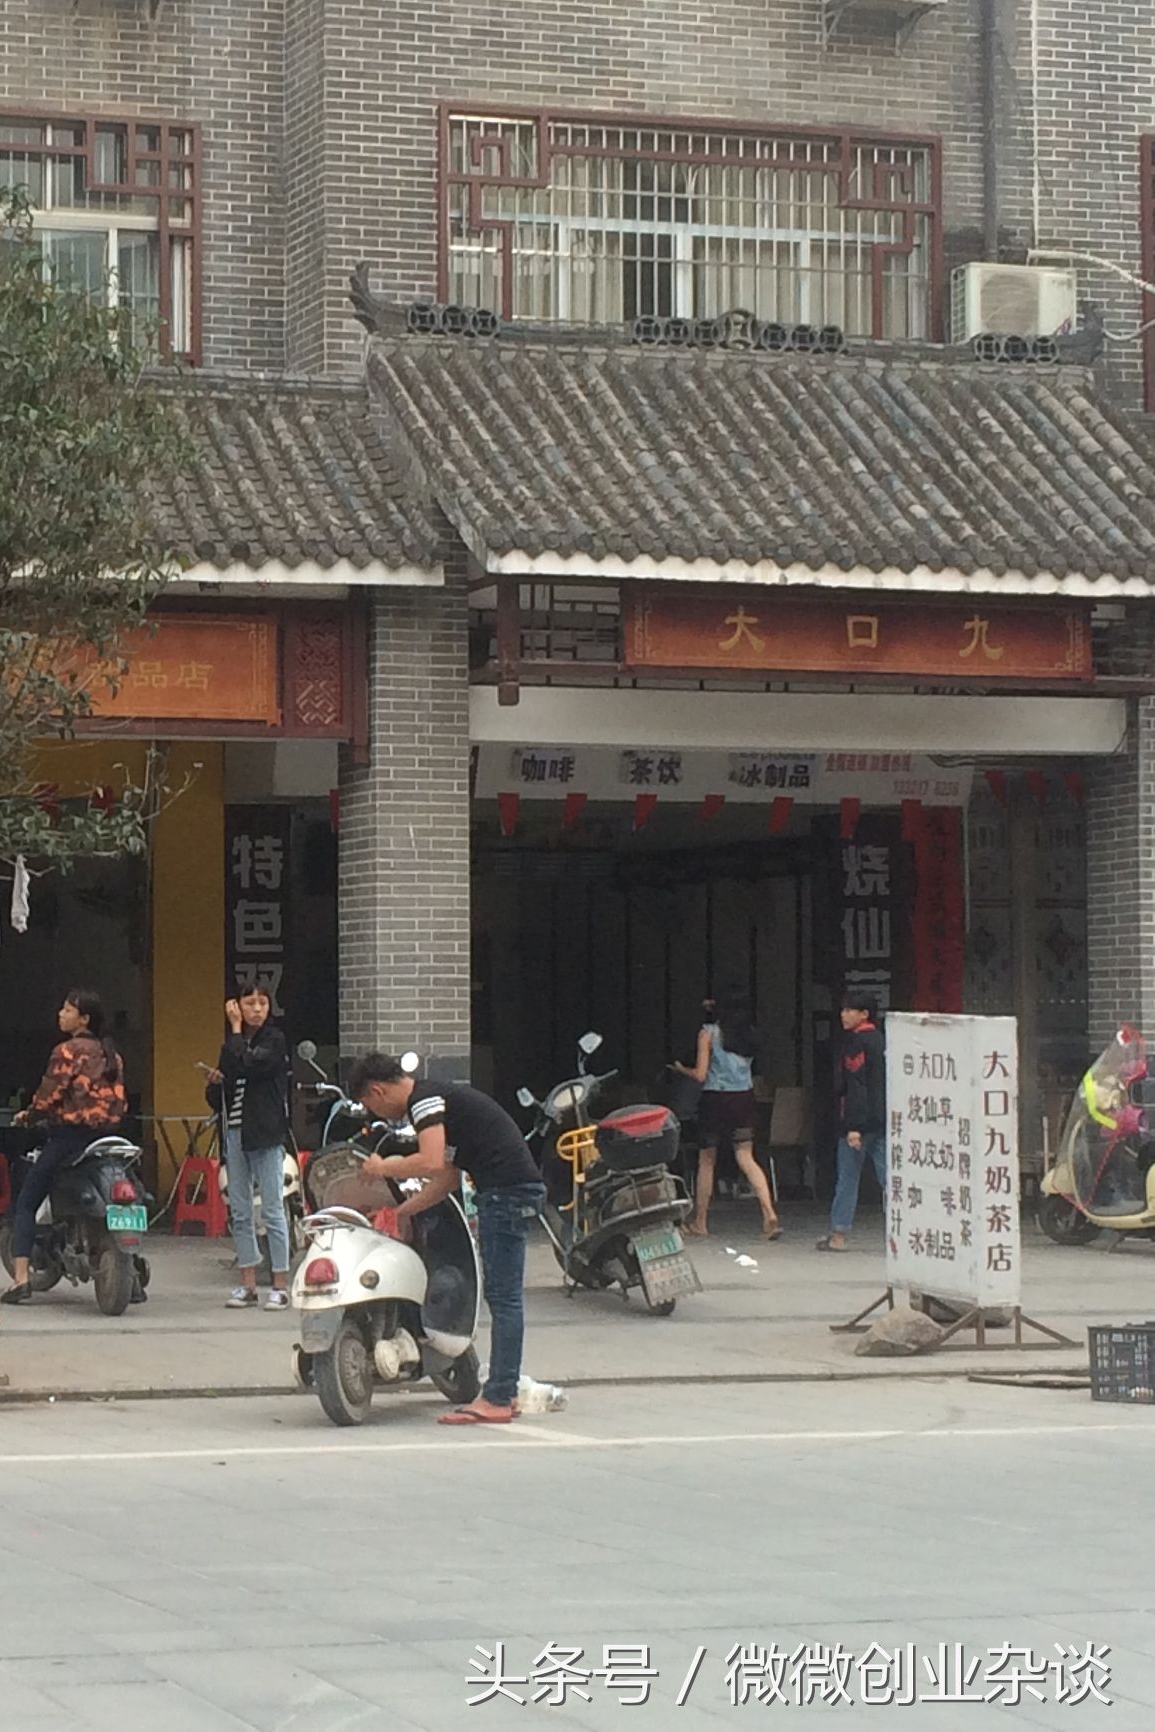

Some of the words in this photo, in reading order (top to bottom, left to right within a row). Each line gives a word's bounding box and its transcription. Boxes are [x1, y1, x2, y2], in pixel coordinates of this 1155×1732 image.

[718, 605, 1003, 660] 大口九
[520, 755, 576, 783] 咖啡
[629, 755, 681, 785] 茶饮
[739, 760, 811, 788] 冰制品
[919, 1052, 958, 1082] 大口九
[908, 1096, 954, 1126] 烧仙草
[908, 1139, 955, 1172] 双皮奶
[983, 1050, 1013, 1273] 大口九奶茶店
[908, 1227, 956, 1261] 冰制品
